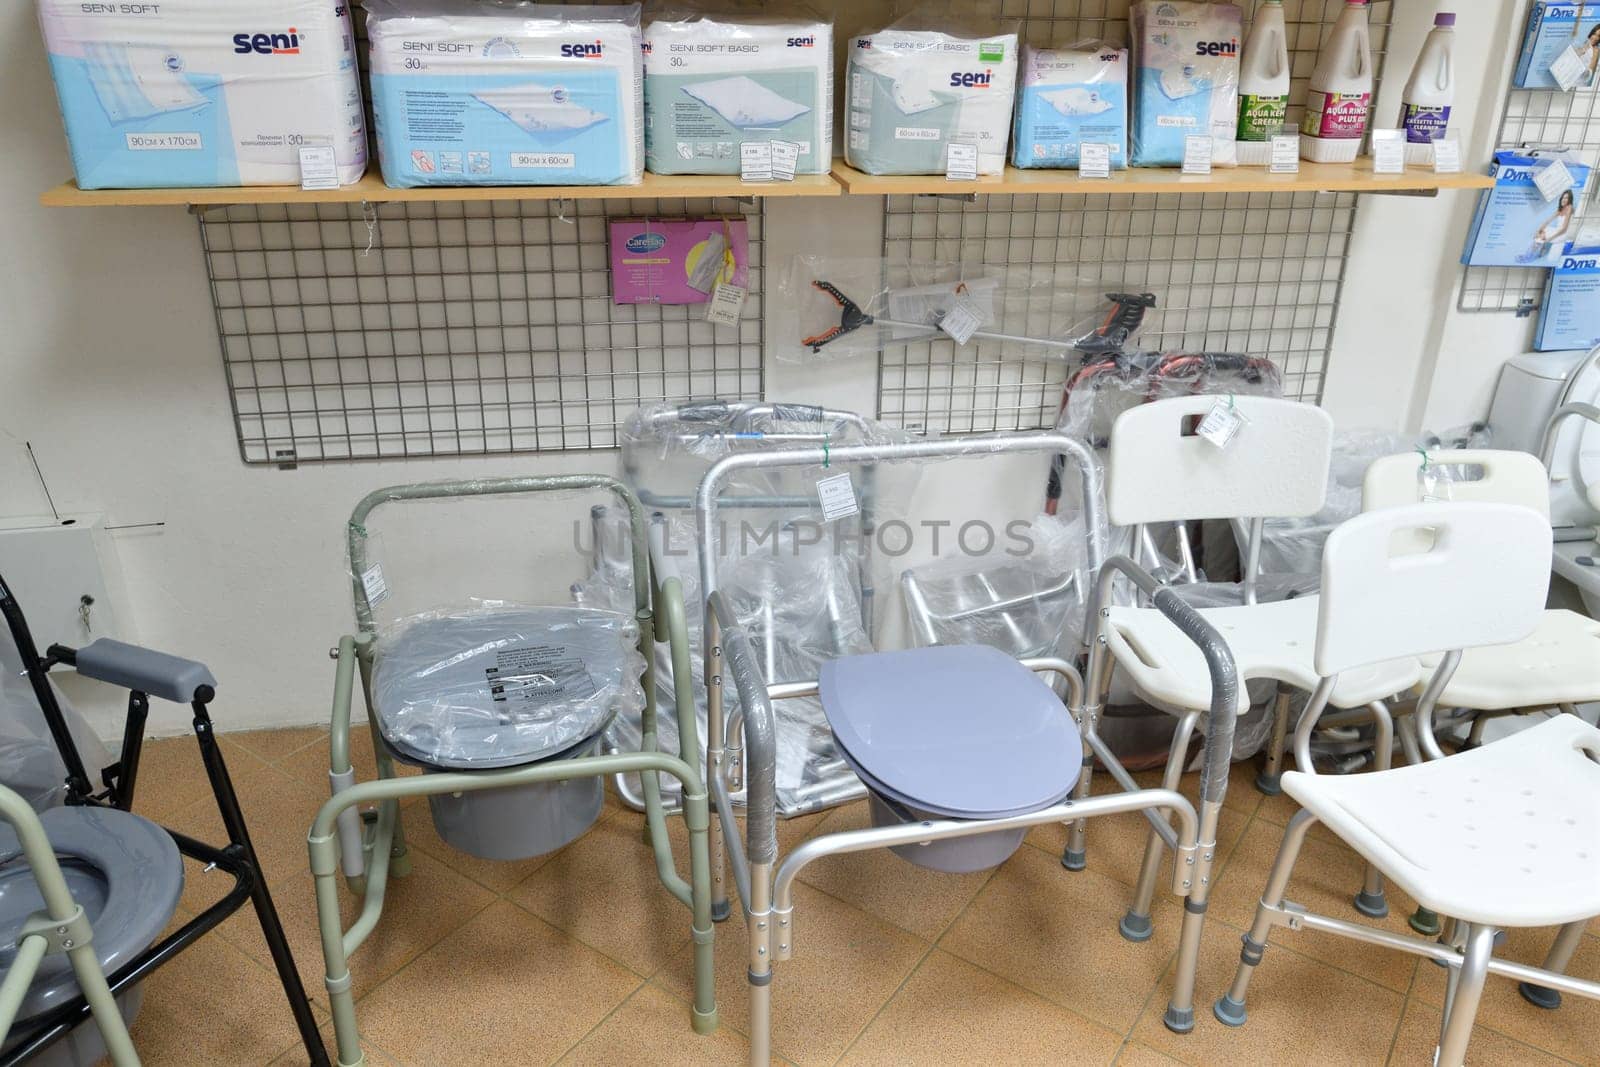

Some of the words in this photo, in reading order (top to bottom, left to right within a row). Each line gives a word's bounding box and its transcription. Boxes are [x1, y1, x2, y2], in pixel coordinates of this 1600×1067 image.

[81, 3, 116, 14] SENI
[120, 3, 160, 14] SOFT
[233, 27, 300, 55] seni
[787, 34, 815, 47] seni
[1196, 36, 1237, 57] seni
[402, 41, 434, 53] SENI
[438, 41, 475, 54] SOFT
[561, 39, 602, 58] seni
[670, 43, 694, 53] SENI
[696, 43, 725, 53] SOFT
[728, 43, 760, 53] BASIC
[943, 43, 971, 52] BASIC
[404, 57, 421, 70] 30
[670, 57, 683, 67] 30
[950, 68, 992, 89] seni
[1246, 109, 1269, 118] AQUA
[1326, 107, 1348, 116] AQUA
[1252, 118, 1278, 126] GREEN
[1337, 115, 1357, 123] PLUS
[287, 134, 304, 146] 30
[1562, 257, 1597, 271] Dyna
